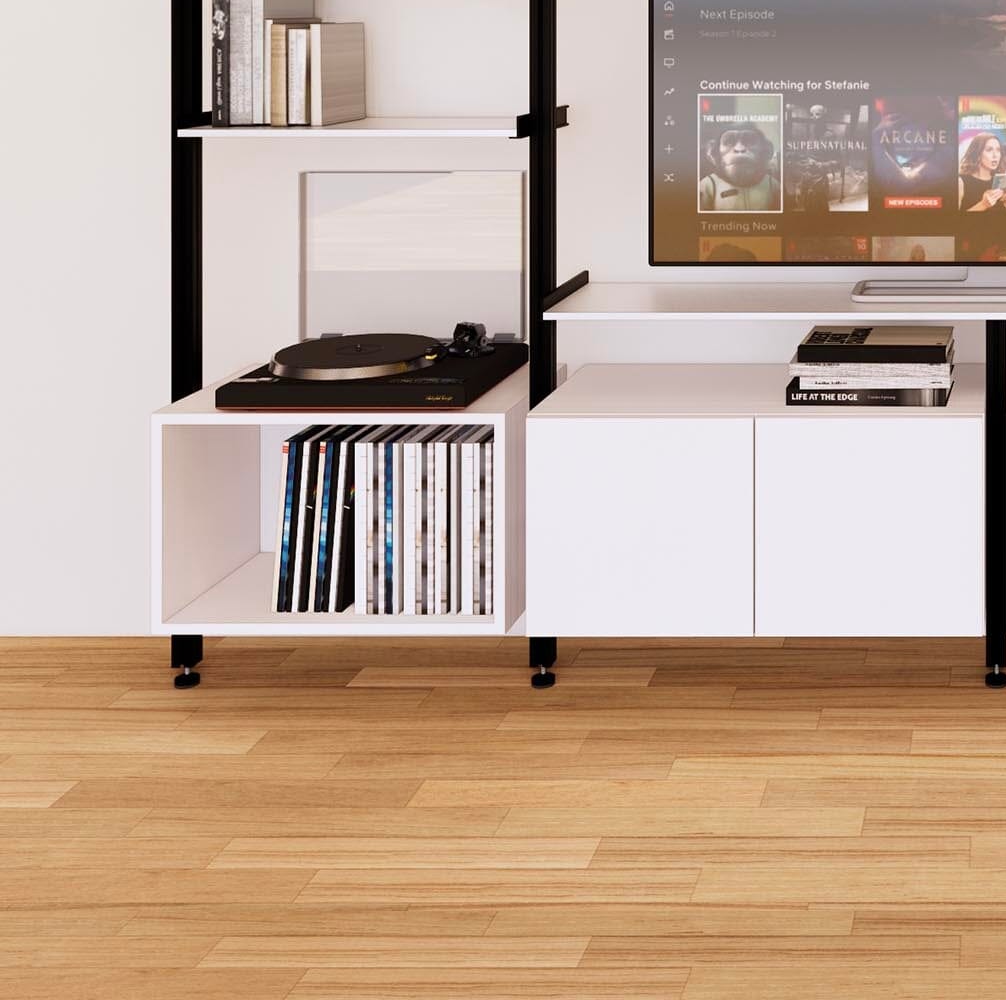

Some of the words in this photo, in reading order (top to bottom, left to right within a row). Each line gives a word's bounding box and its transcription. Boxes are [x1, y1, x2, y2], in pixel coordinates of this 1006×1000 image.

[700, 9, 726, 20] Next
[730, 8, 775, 22] Episode
[700, 80, 749, 90] Continue
[752, 80, 804, 92] Watching
[806, 80, 821, 90] for
[825, 80, 870, 90] Stefanie
[880, 130, 947, 144] ARCANE
[786, 140, 867, 150] SUPERNATURAL
[701, 221, 750, 232] Trending
[752, 221, 777, 231] Now
